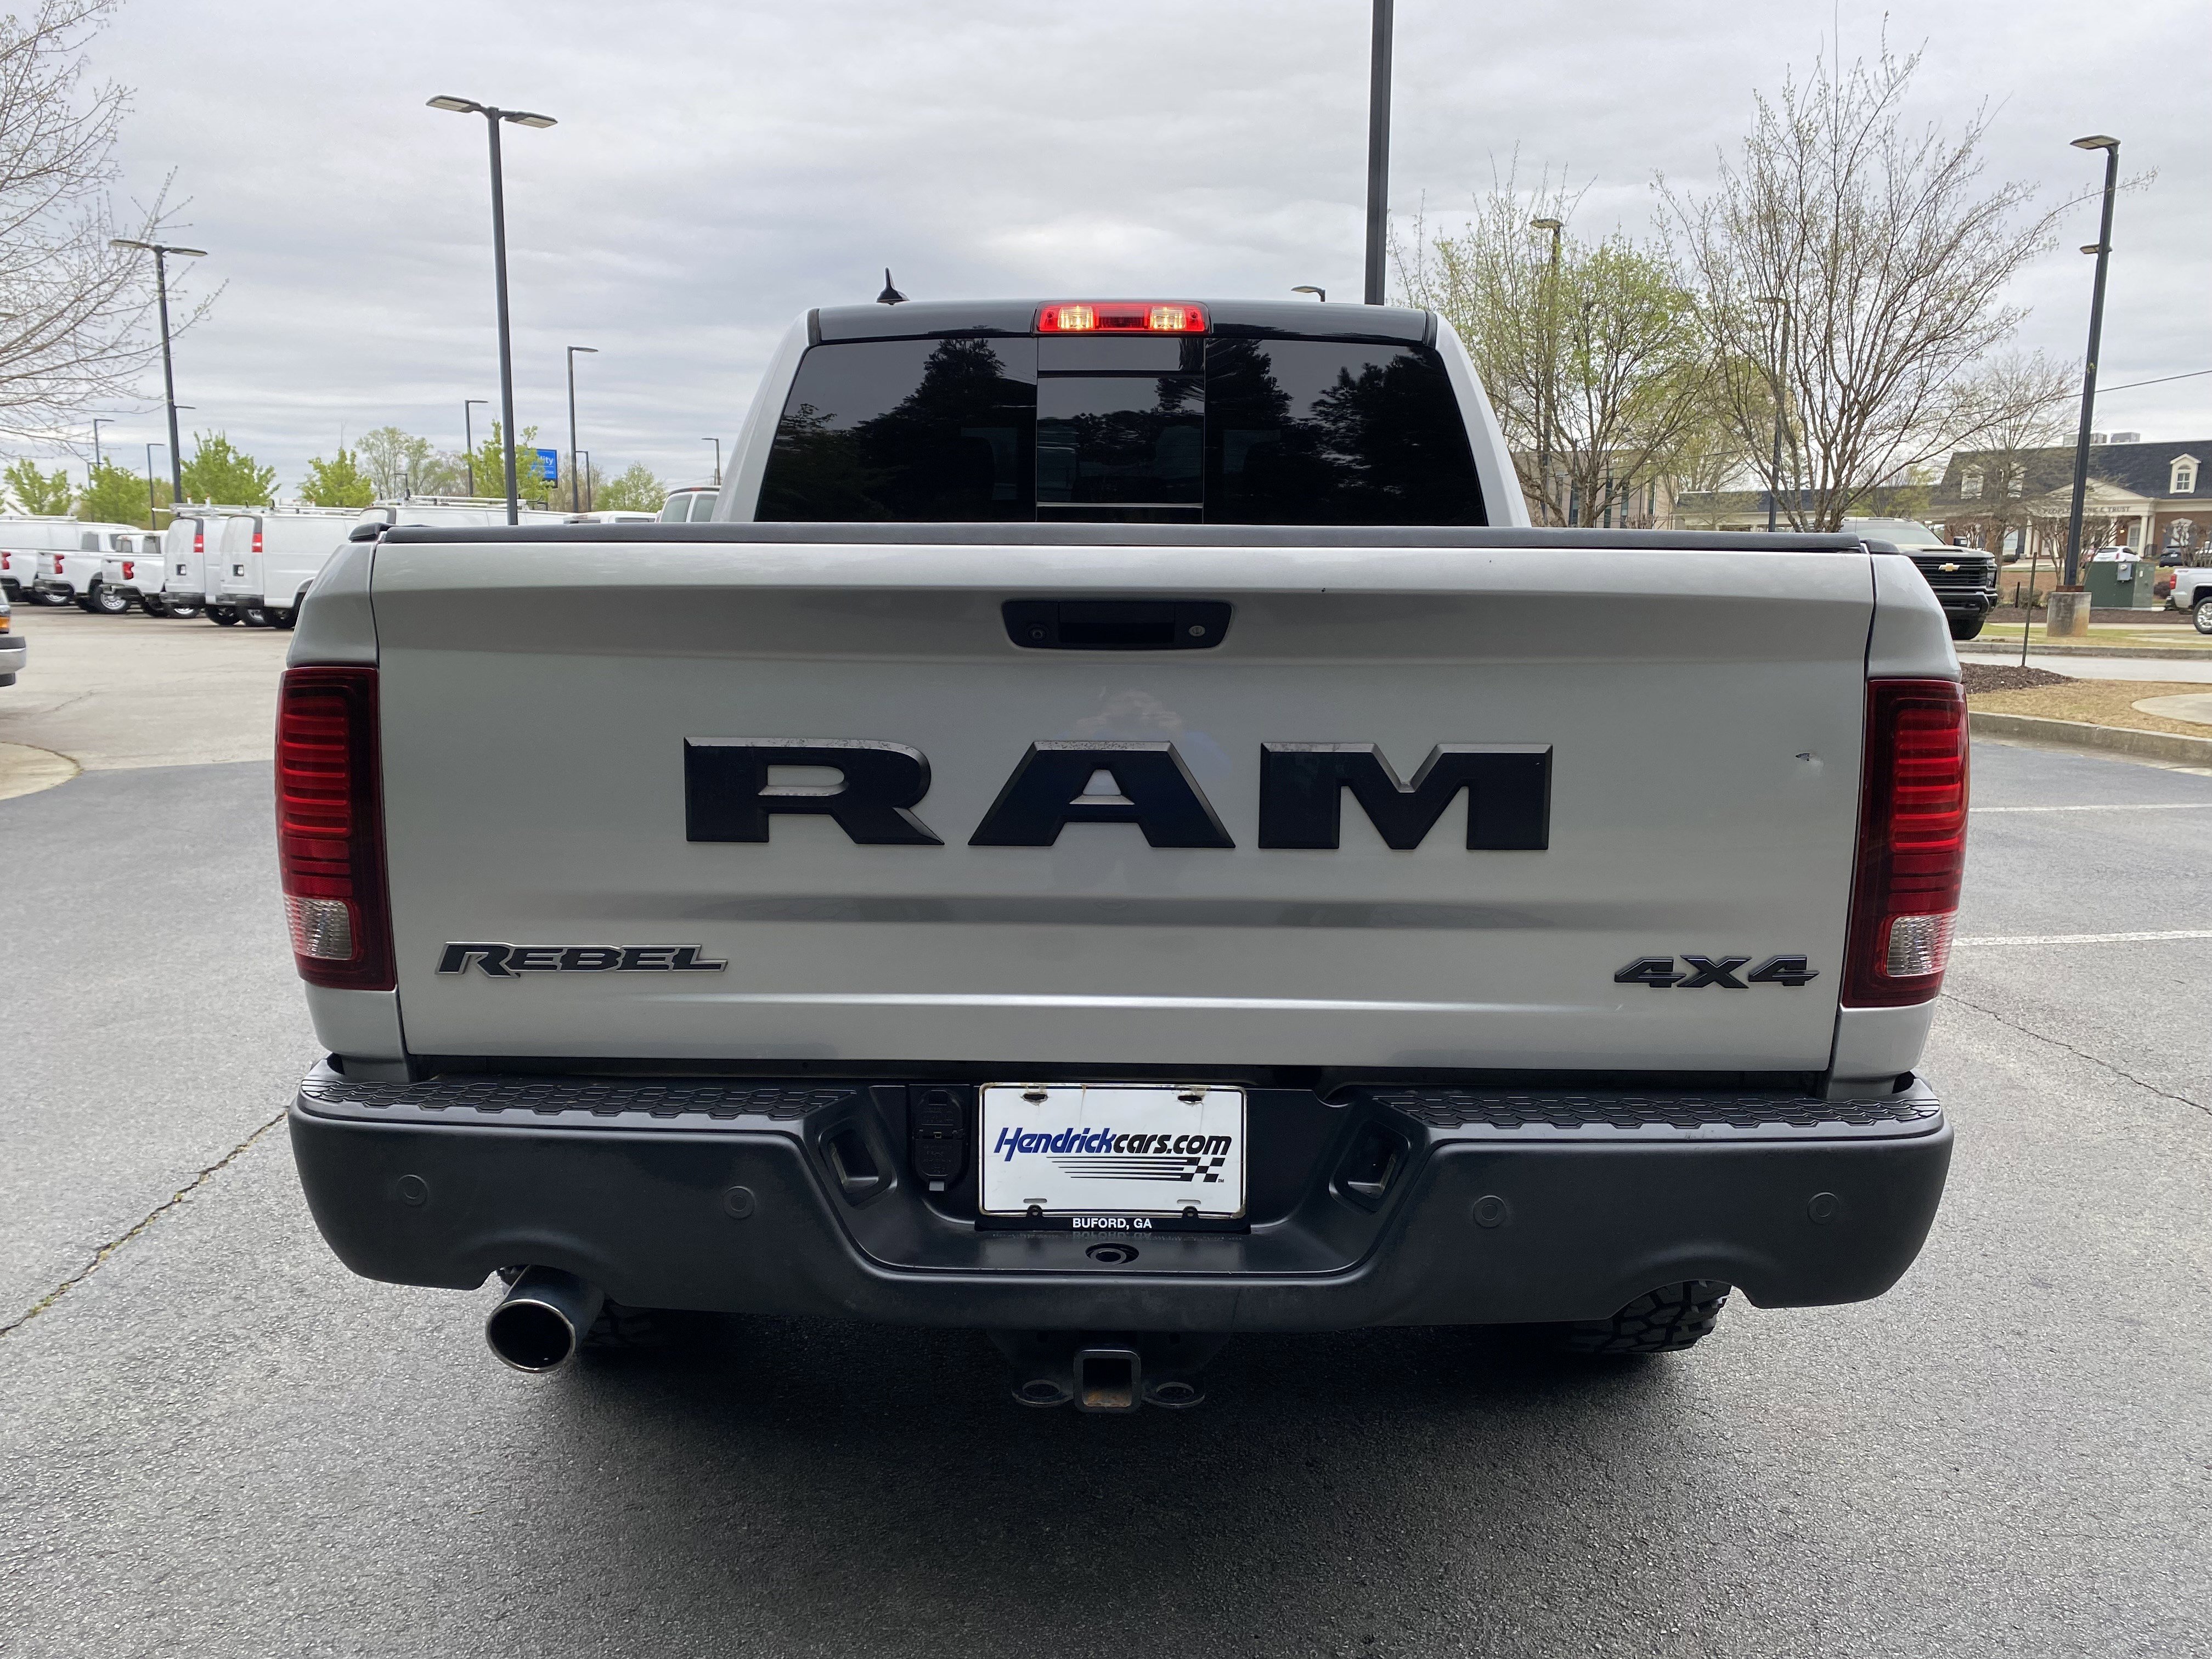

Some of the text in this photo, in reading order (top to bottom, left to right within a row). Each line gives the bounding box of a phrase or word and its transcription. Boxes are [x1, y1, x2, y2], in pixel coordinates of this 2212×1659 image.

[684, 736, 1554, 850] RAM
[435, 941, 727, 978] REBEL
[993, 1127, 1232, 1162] Hendrickcars.com
[1073, 1218, 1152, 1230] BUFORD, GA
